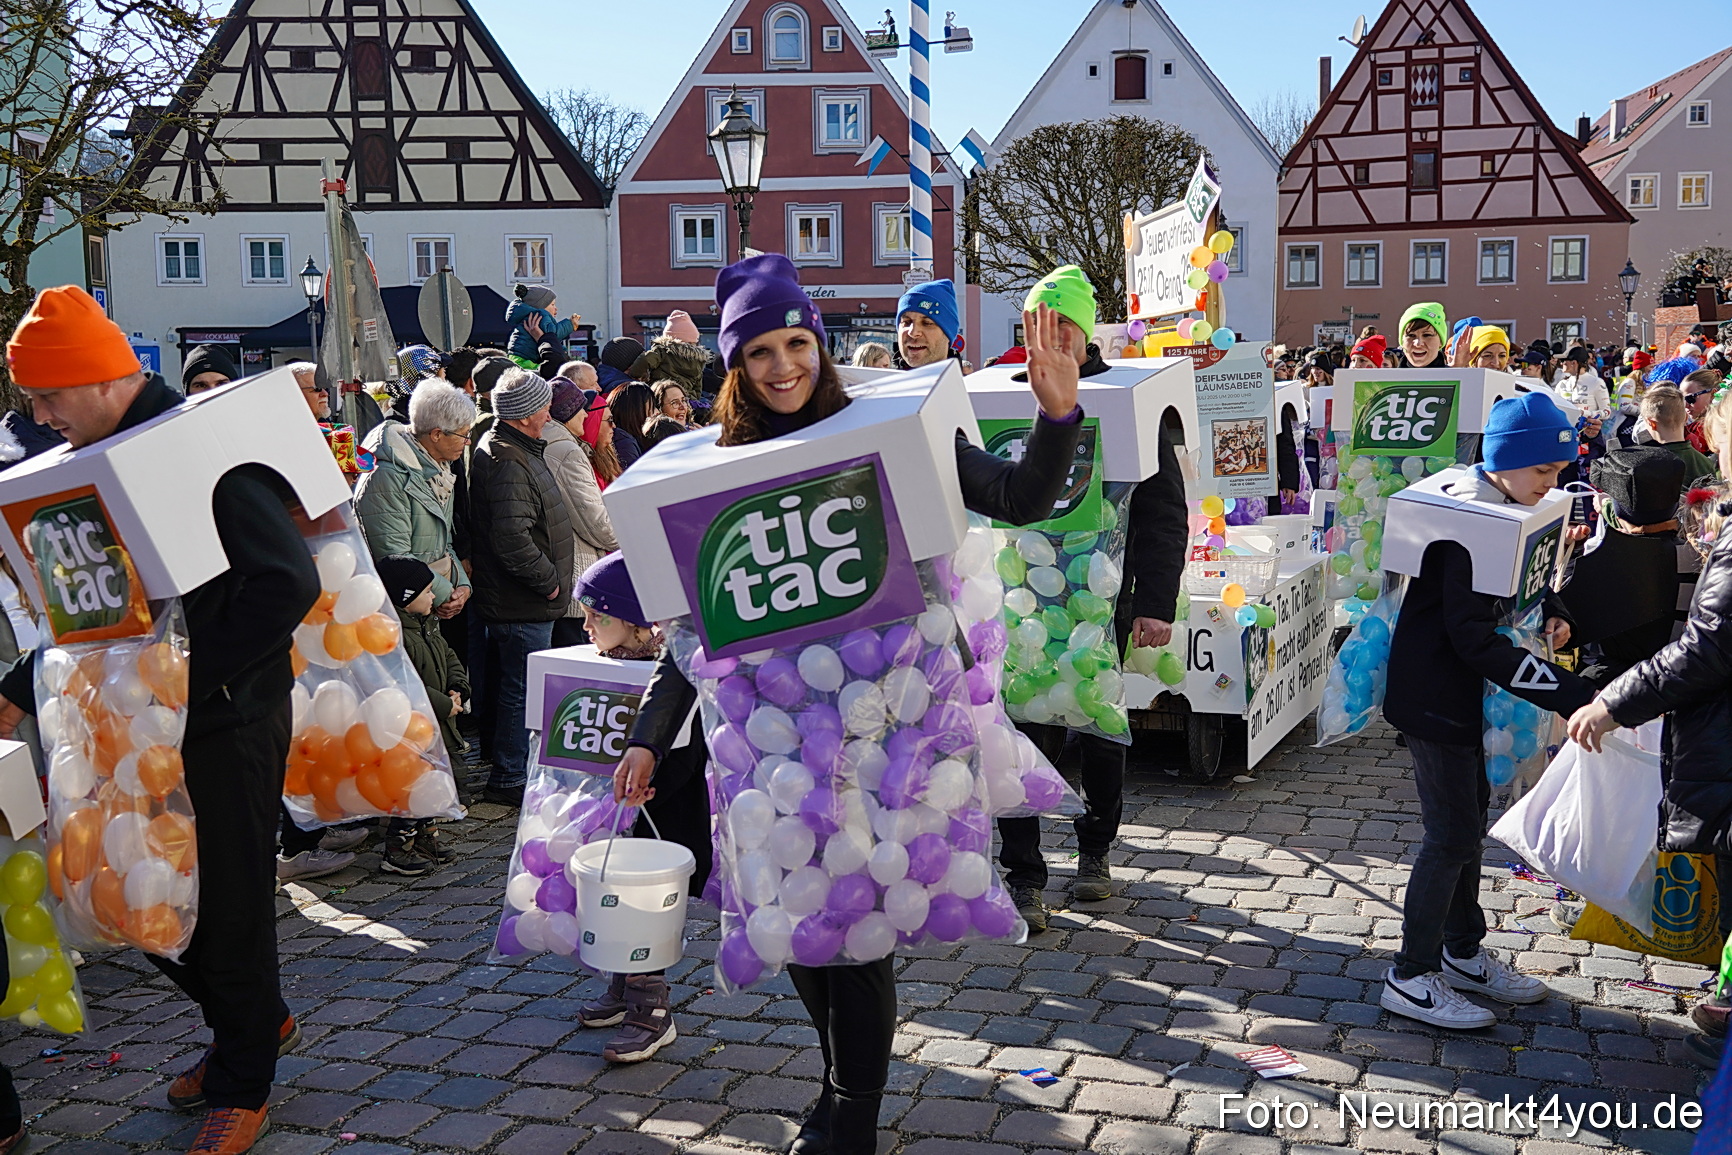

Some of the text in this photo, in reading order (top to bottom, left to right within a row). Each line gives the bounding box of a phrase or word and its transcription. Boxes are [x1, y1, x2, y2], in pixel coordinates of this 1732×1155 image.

[1167, 347, 1208, 357] 125 JAHRE
[1196, 371, 1263, 383] DEIFLSWILDER
[1196, 380, 1263, 392] ILÄUMSABEND
[1386, 390, 1440, 419] tic
[1370, 416, 1435, 442] tac
[44, 512, 108, 570] tic
[741, 494, 858, 566] tic
[1534, 536, 1557, 572] tic
[53, 565, 123, 616] tac
[723, 547, 867, 622] tac
[1524, 563, 1550, 601] tac
[1276, 631, 1297, 673] macht
[1297, 621, 1312, 654] euch
[1312, 603, 1328, 640] bereit
[578, 695, 630, 731] tic
[1250, 707, 1263, 741] am
[1264, 678, 1286, 726] 26.07.
[1287, 670, 1296, 703] ist
[562, 720, 626, 757] tac
